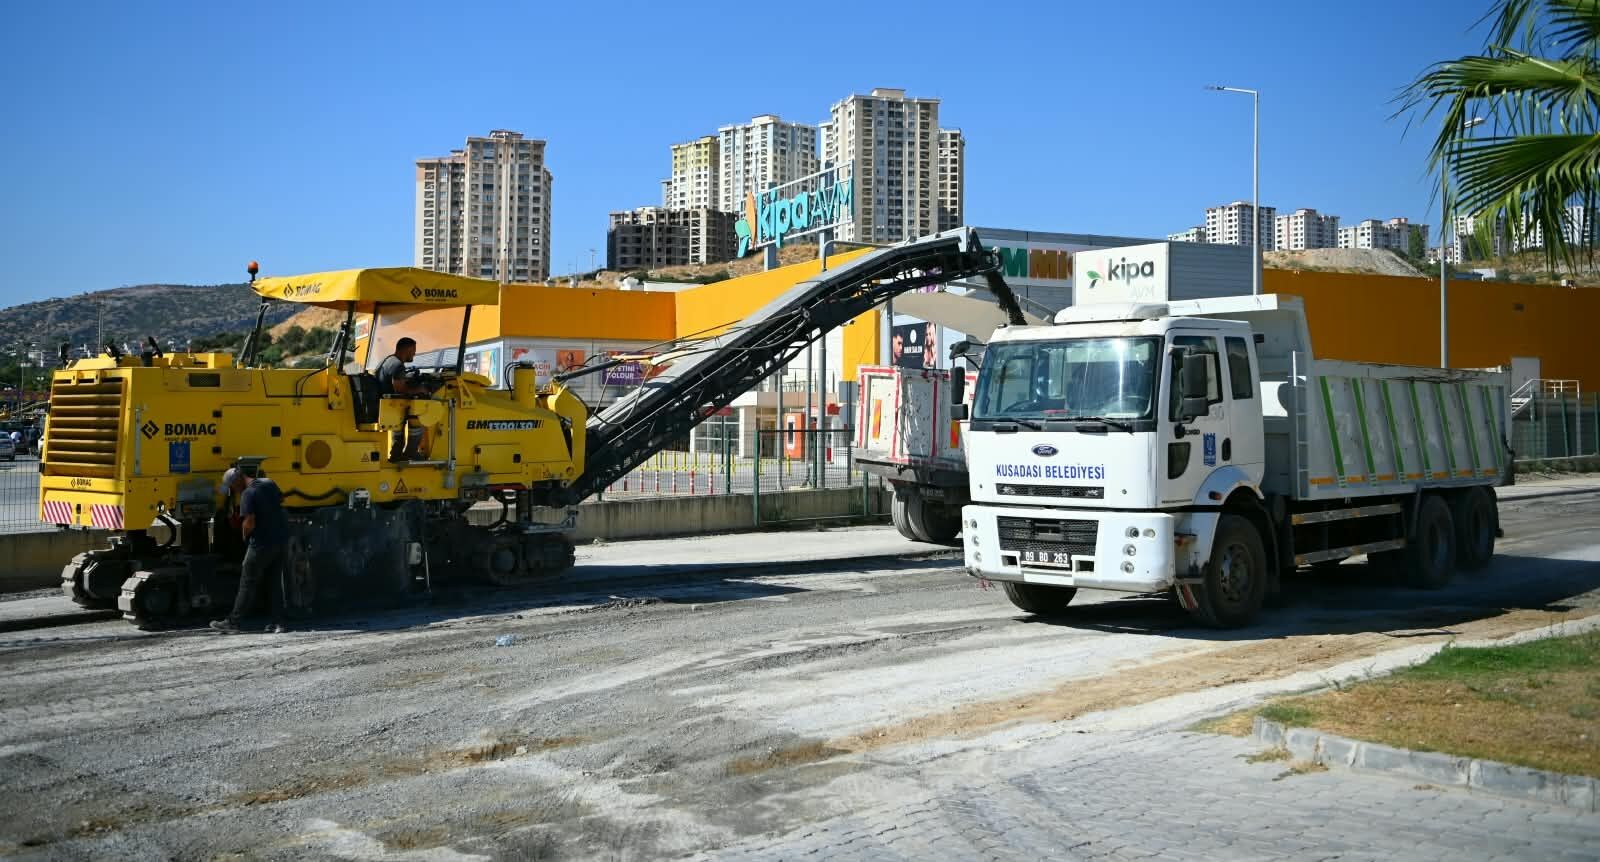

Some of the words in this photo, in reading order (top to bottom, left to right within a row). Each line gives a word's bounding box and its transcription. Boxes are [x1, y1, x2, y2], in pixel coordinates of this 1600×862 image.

[757, 187, 810, 248] kipa
[811, 177, 854, 227] AVM
[1107, 256, 1155, 286] kipa
[425, 288, 457, 298] BOMAG
[164, 423, 217, 436] BOMAG
[1045, 463, 1105, 480] BELEDİYESİ
